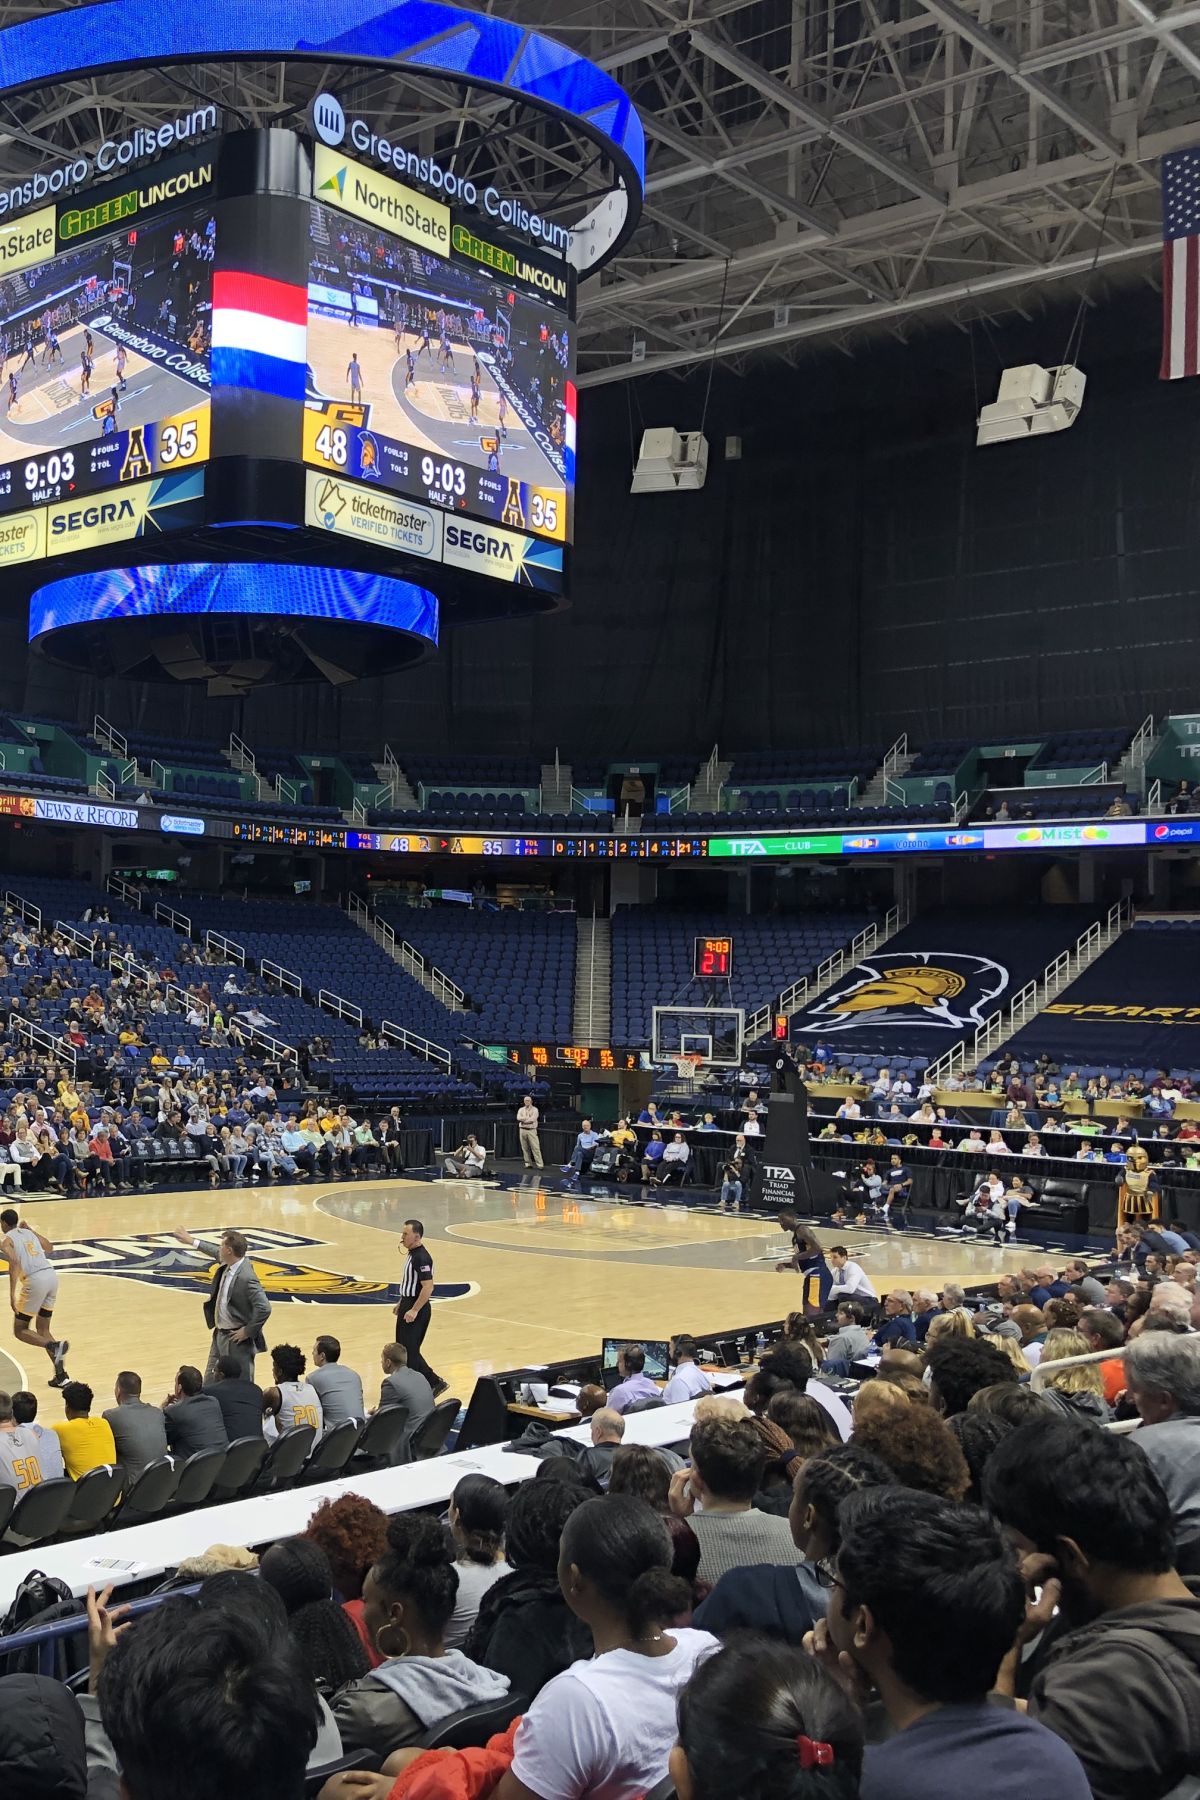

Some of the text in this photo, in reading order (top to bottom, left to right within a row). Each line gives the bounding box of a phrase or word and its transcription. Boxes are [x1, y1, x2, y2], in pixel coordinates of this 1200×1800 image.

[96, 105, 217, 172] Coliseum
[351, 119, 571, 250] Greensboro Coliseum
[59, 163, 212, 240] GREEN LINCOLN
[355, 179, 448, 243] NorthState
[452, 224, 567, 299] GREEN LINCOLN
[103, 322, 168, 358] Greensboro
[489, 366, 536, 428] Greensboro
[160, 420, 198, 464] 35
[315, 426, 348, 465] 48
[91, 444, 120, 457] 4 FOULS
[384, 446, 408, 461] FOULS 3
[25, 452, 75, 491] 9:03
[90, 460, 111, 472] 2 TOL
[403, 466, 408, 476] 3
[5, 471, 11, 480] 3
[421, 456, 466, 495] 9:03
[5, 484, 11, 494] 3
[479, 477, 502, 491] 4 FOULS
[32, 488, 52, 502] HALF
[55, 486, 61, 496] 2
[428, 490, 447, 503] HALF
[449, 495, 454, 506] 2
[478, 491, 484, 500] 2
[52, 499, 135, 535] SEGRA
[352, 495, 427, 532] ticketmaster
[531, 494, 558, 531] 35
[351, 515, 423, 547] VERIFIED TICKETS
[446, 526, 513, 561] SEGRA
[35, 799, 138, 827] NEWS & RECORD
[234, 825, 240, 834] 0
[255, 828, 261, 837] 2
[275, 830, 283, 839] 14
[298, 831, 307, 841] 21
[1041, 828, 1081, 840] Mist
[1170, 827, 1193, 837] pepsi
[322, 834, 333, 843] 44
[390, 837, 409, 852] 48
[784, 841, 811, 850] CLUB
[483, 841, 502, 855] 35
[556, 843, 563, 852] 0
[589, 843, 594, 852] 1
[620, 843, 626, 852] 2
[651, 843, 658, 852] 4
[680, 843, 691, 852] 21
[728, 840, 767, 854] TFA
[706, 942, 728, 952] 9:03
[702, 953, 726, 973] 21
[533, 1054, 547, 1064] 48
[564, 1049, 589, 1059] 9:03
[601, 1057, 614, 1067] 35
[628, 1058, 634, 1068] 2
[763, 1166, 796, 1180] TFA
[762, 1188, 795, 1197] FINANCIAL
[763, 1195, 794, 1203] ADVISORS
[293, 1405, 319, 1429] 20
[12, 1456, 41, 1489] 50
